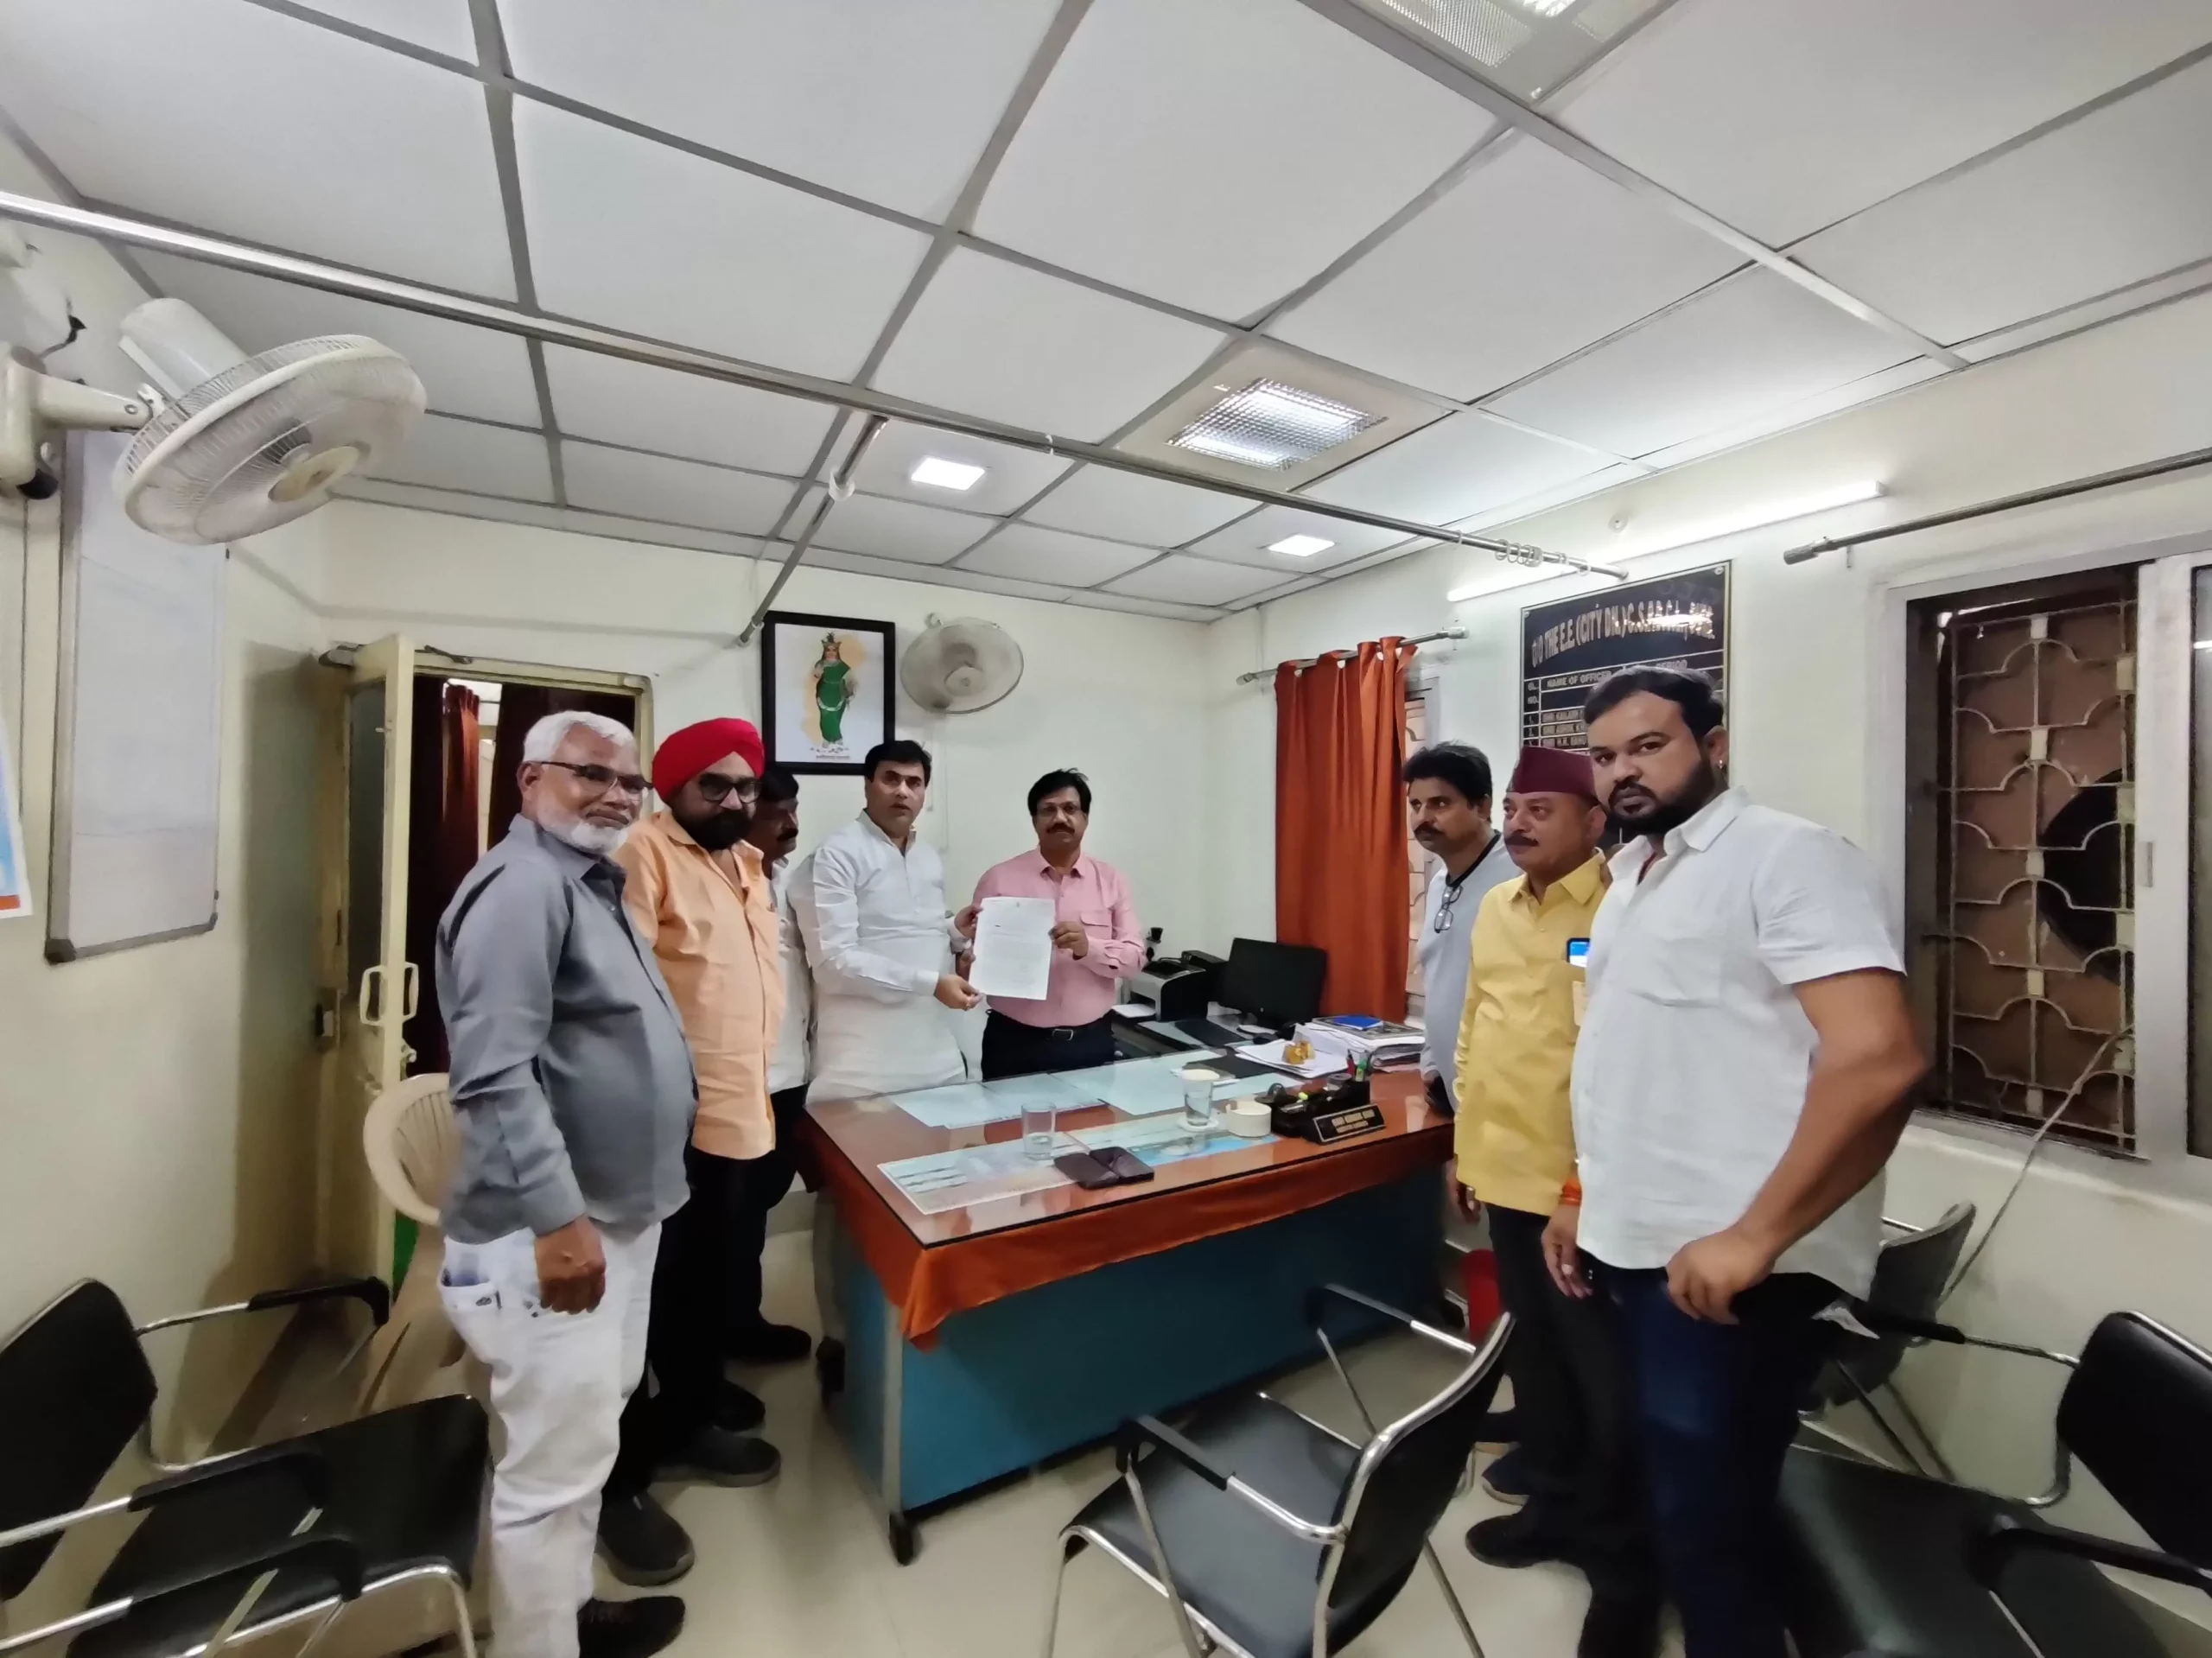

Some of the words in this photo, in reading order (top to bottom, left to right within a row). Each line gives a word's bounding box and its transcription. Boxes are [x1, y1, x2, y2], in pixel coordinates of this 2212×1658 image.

[1544, 626, 1559, 660] THE
[1547, 677, 1567, 688] NAME
[1568, 676, 1579, 685] OF
